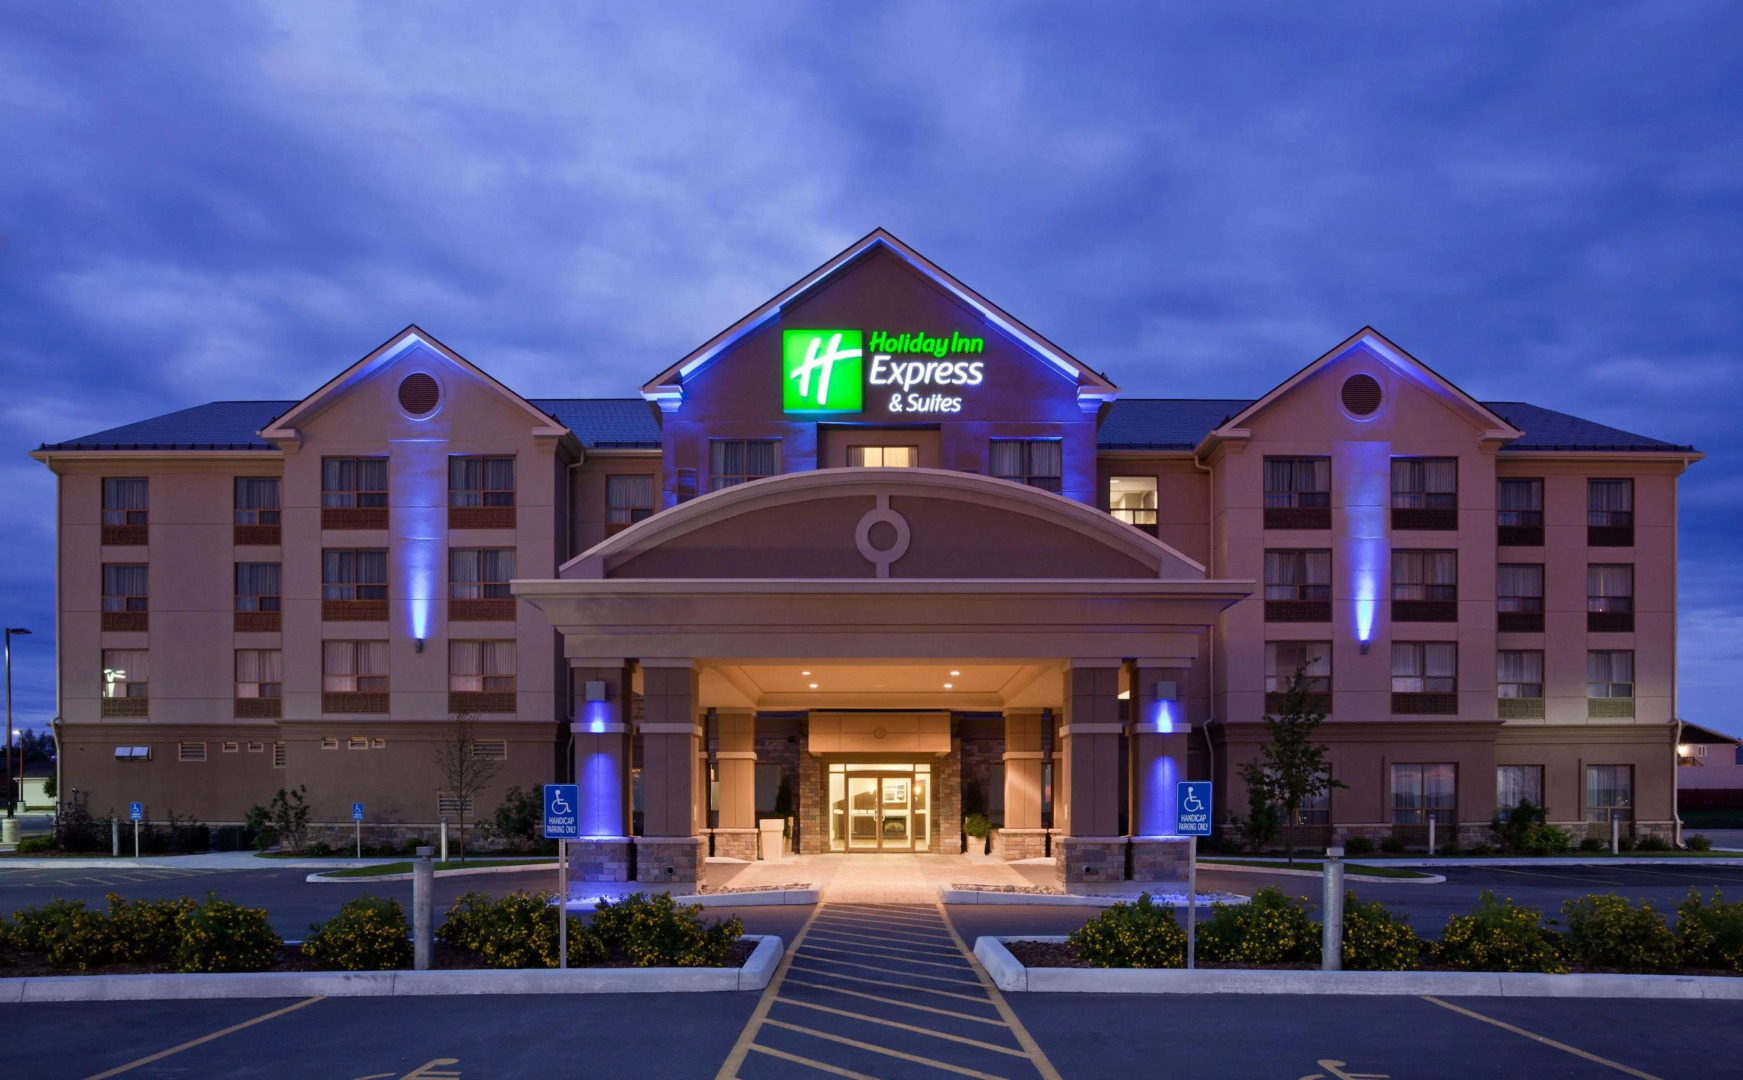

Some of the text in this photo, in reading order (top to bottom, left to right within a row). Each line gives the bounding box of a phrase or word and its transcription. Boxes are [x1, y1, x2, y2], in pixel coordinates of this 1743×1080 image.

[869, 331, 984, 357] Holiday Inn
[869, 355, 984, 392] Express
[888, 394, 962, 412] & Suites
[1181, 814, 1206, 822] HANDICAP
